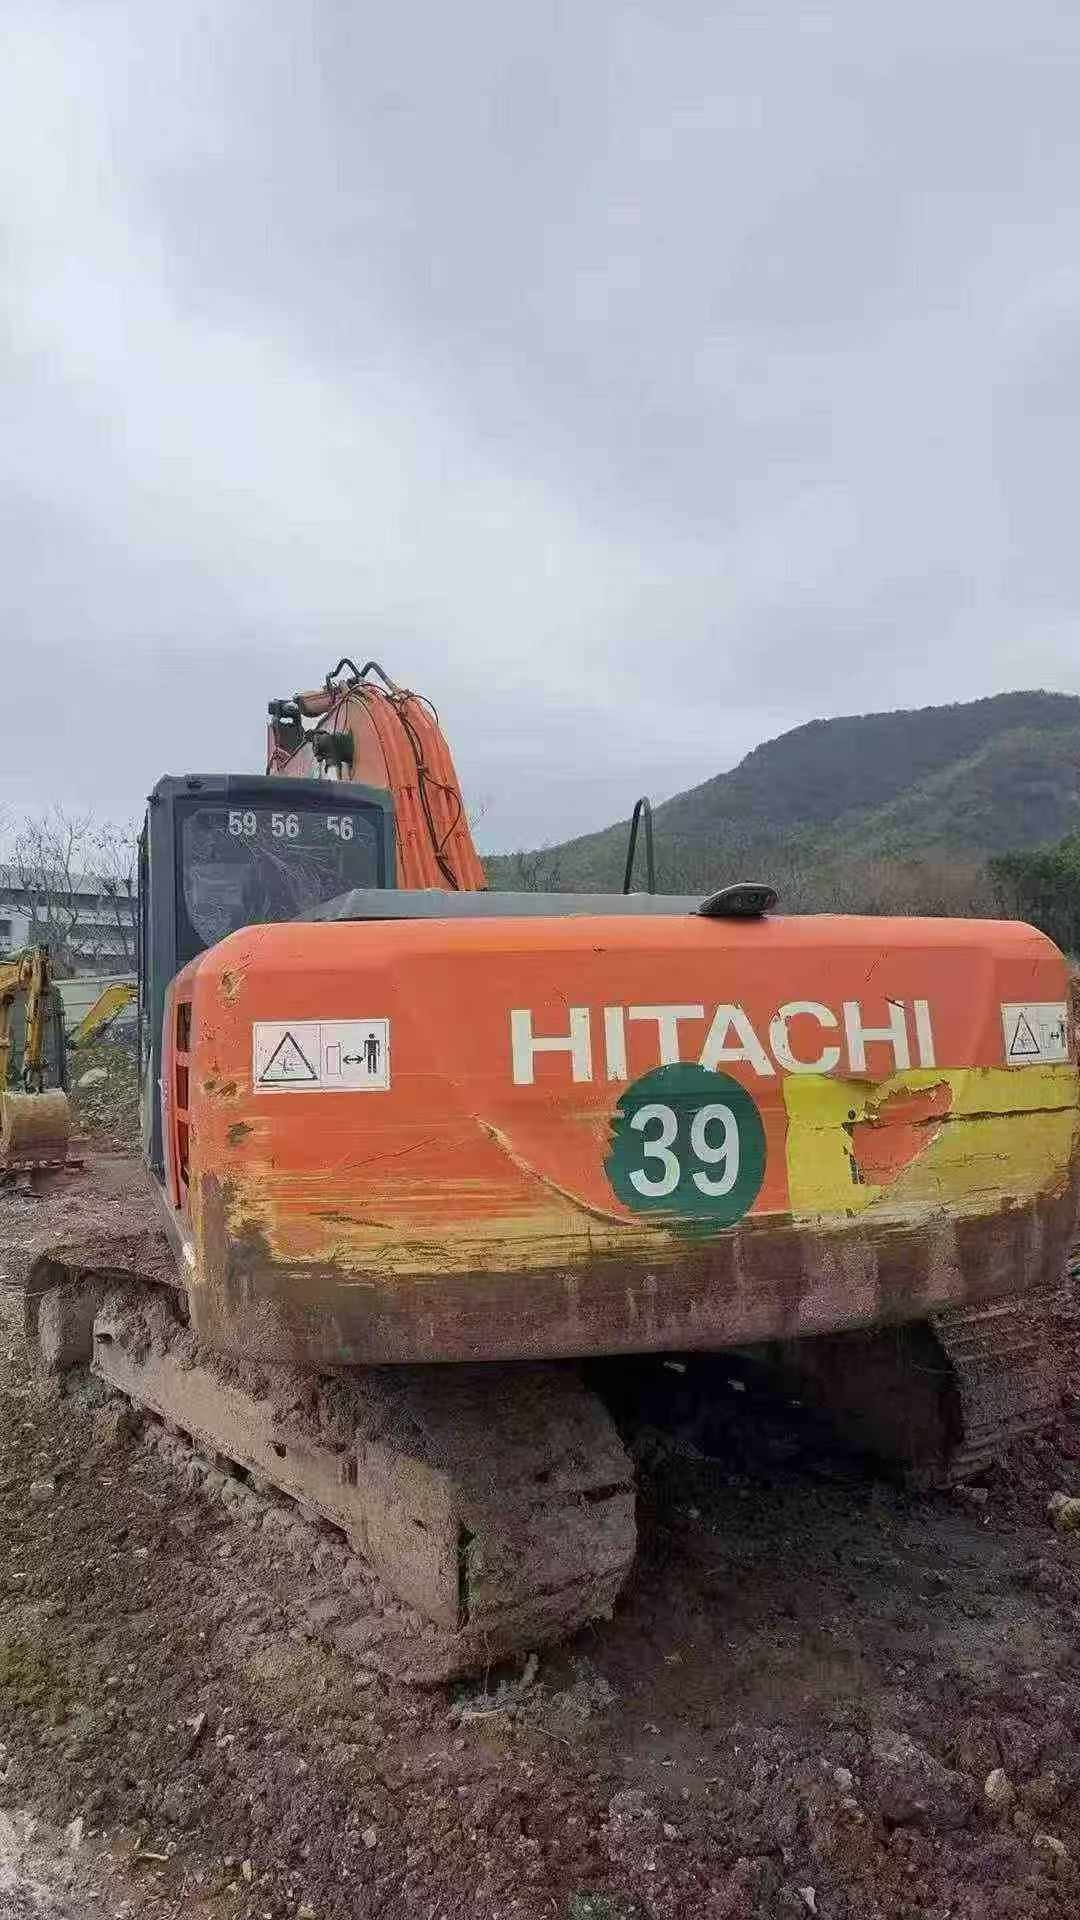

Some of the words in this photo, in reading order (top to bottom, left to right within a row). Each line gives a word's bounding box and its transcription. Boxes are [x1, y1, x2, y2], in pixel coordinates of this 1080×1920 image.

[271, 813, 299, 837] 56
[510, 1000, 936, 1085] HITACHI
[629, 1103, 740, 1197] 39
